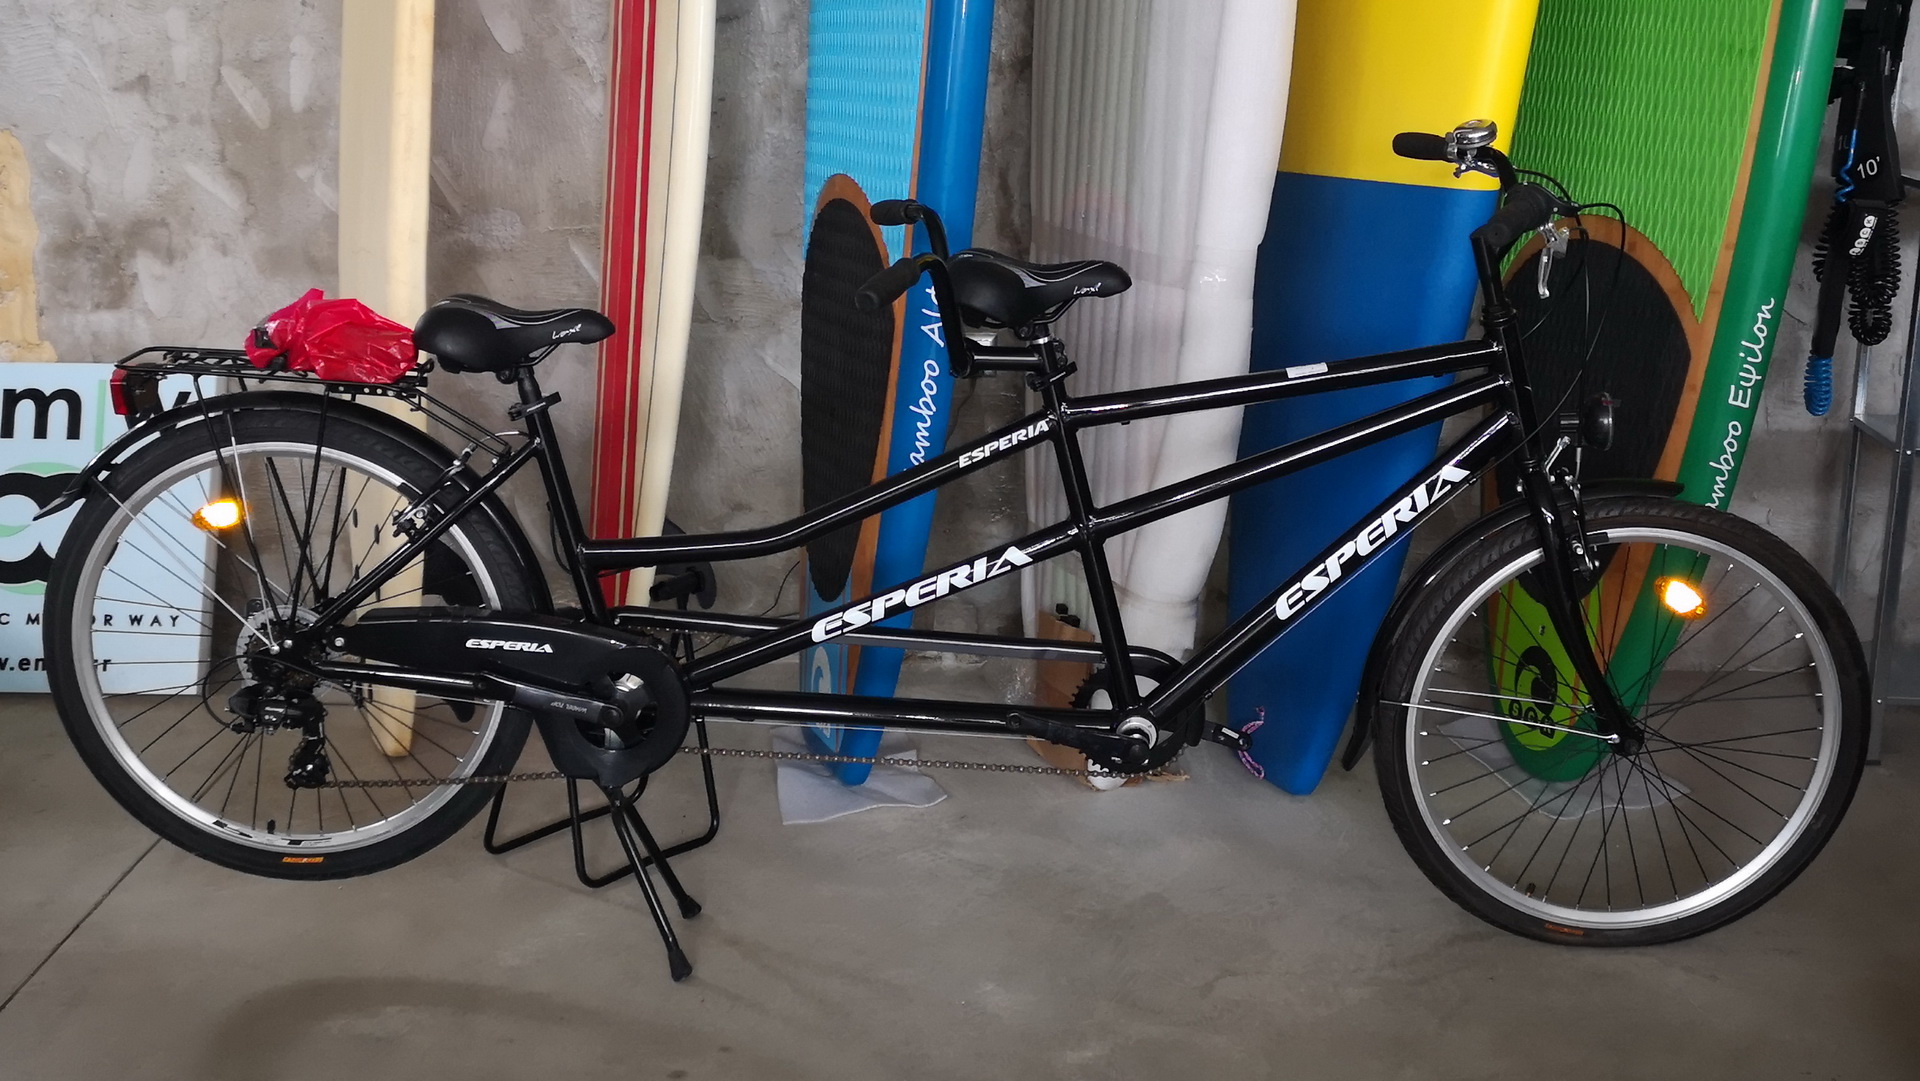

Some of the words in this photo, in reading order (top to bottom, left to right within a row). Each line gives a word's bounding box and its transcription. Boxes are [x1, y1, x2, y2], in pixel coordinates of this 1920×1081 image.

[1857, 156, 1880, 179] 10'
[904, 359, 940, 470] amboo
[959, 418, 1051, 468] ESPERIA
[1705, 421, 1742, 510] mboo
[1275, 464, 1471, 621] ESPERIA
[129, 614, 180, 627] WAY
[811, 546, 1033, 643] ESPERIA
[465, 638, 553, 653] ESPERIA
